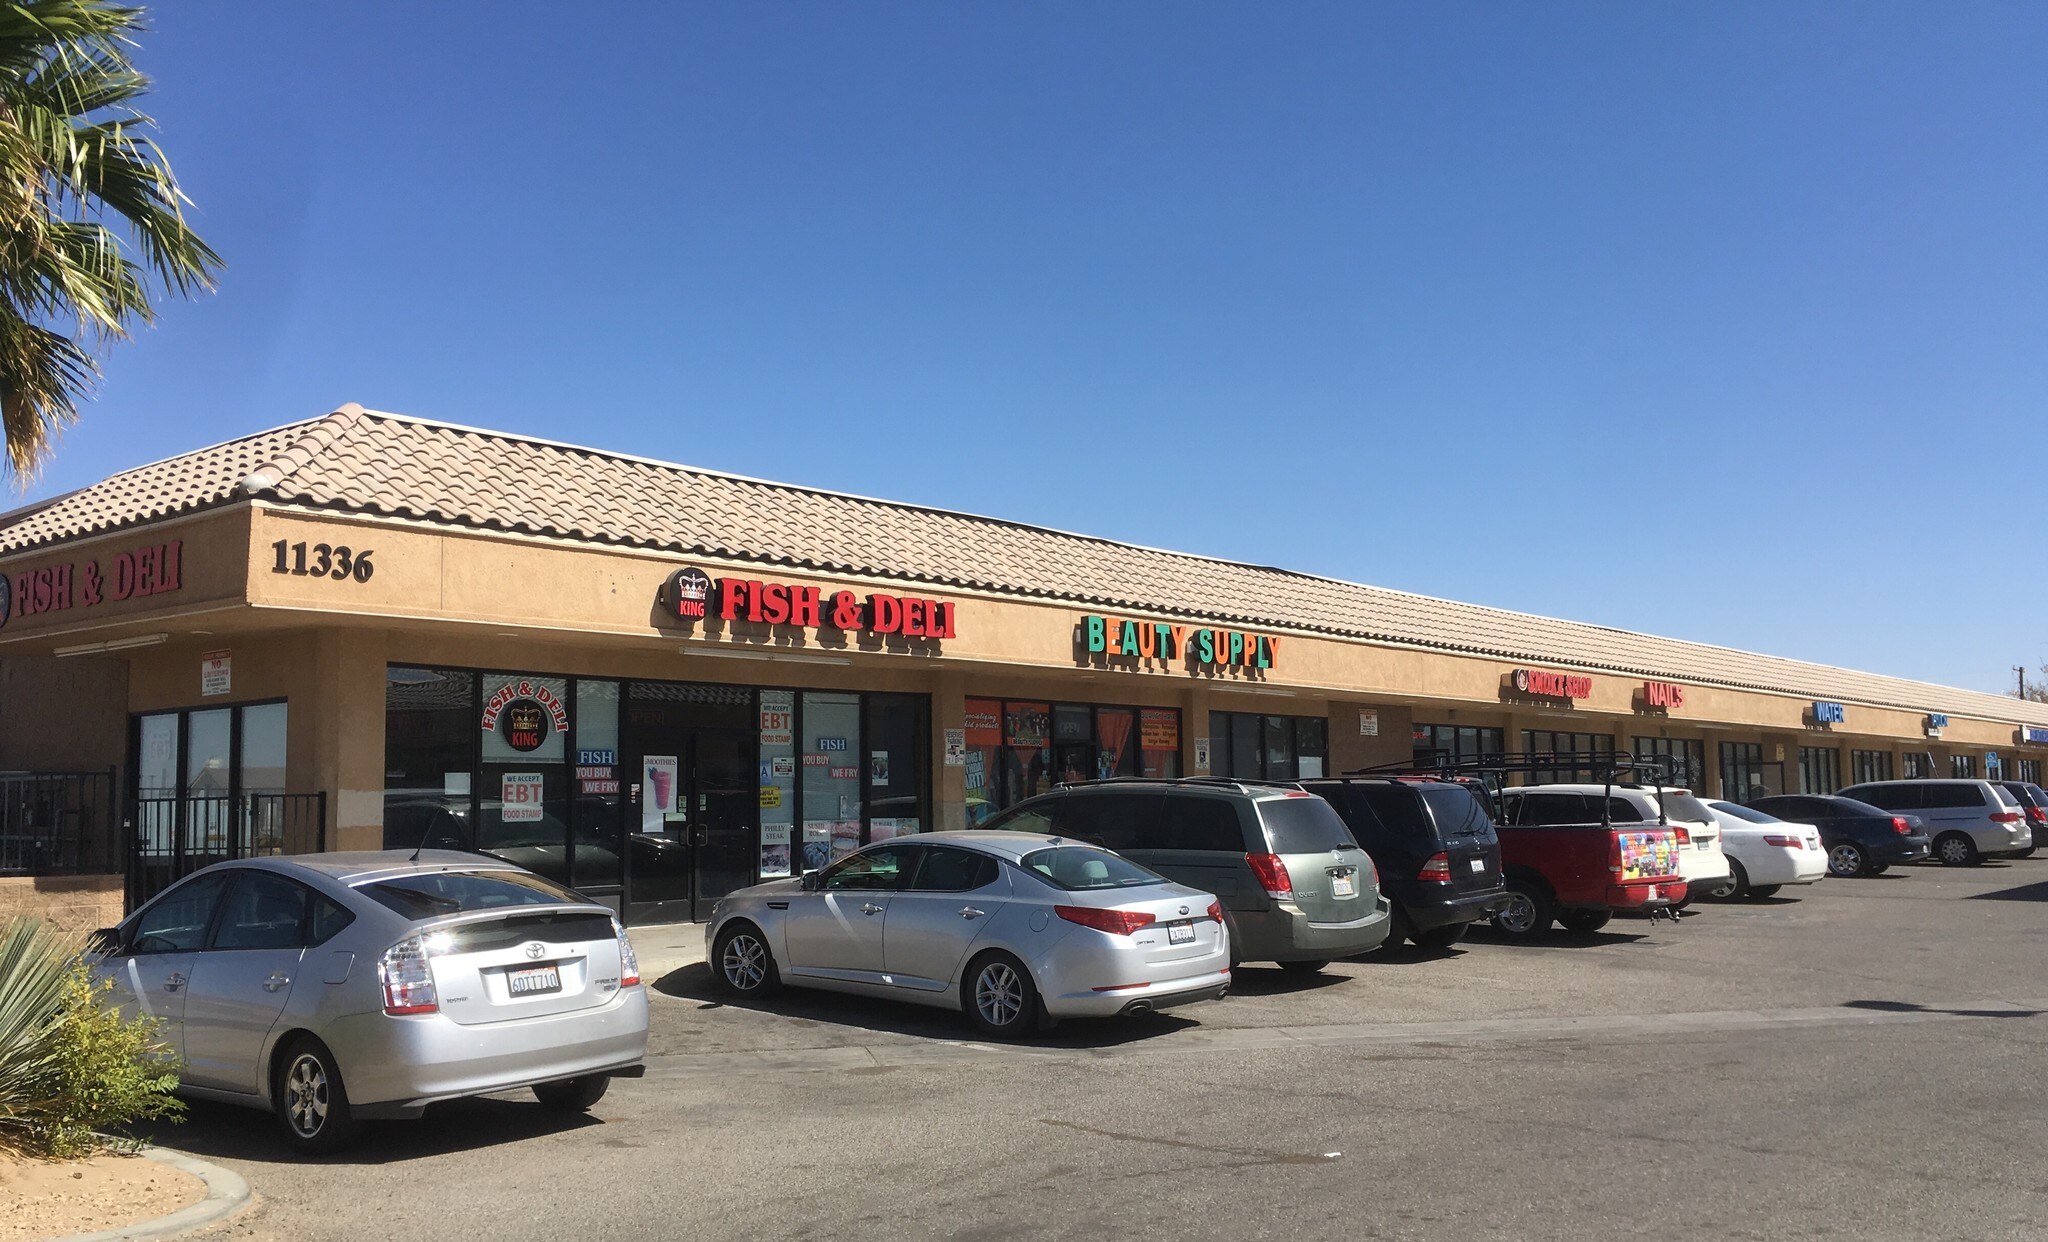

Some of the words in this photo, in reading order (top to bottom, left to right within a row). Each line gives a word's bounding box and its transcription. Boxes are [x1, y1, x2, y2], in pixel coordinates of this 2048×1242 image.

[272, 539, 374, 583] 11336
[12, 564, 73, 617] FISH
[80, 560, 103, 606] &
[112, 540, 183, 600] DELI
[680, 600, 705, 618] KING
[720, 577, 821, 627] FISH
[833, 589, 863, 630] &
[873, 594, 956, 639] DELI
[1086, 616, 1187, 660] BEAUTY
[1199, 628, 1281, 669] SUPPLY
[212, 660, 222, 669] NO
[1528, 670, 1564, 697] SMOKE
[1566, 675, 1592, 699] SHOP
[1648, 681, 1684, 708] NAILS
[481, 684, 516, 732] FISH
[518, 680, 534, 697] &
[535, 686, 570, 732] DELI
[1815, 702, 1844, 723] WATER
[762, 712, 790, 729] EBT
[964, 712, 996, 723] pecializing
[512, 732, 538, 747] KING
[762, 734, 774, 742] FOOD
[820, 739, 846, 750] FISH
[580, 751, 613, 764] FISH
[803, 755, 816, 765] YOU
[816, 755, 830, 765] BUY
[576, 767, 594, 778] YOU
[761, 766, 768, 776] A
[832, 768, 844, 778] WE
[844, 768, 858, 778] FRY
[503, 783, 542, 803] EBT
[585, 782, 600, 792] WE
[600, 782, 618, 792] FRY
[504, 809, 520, 819] FOOD
[521, 809, 542, 819] STAMP
